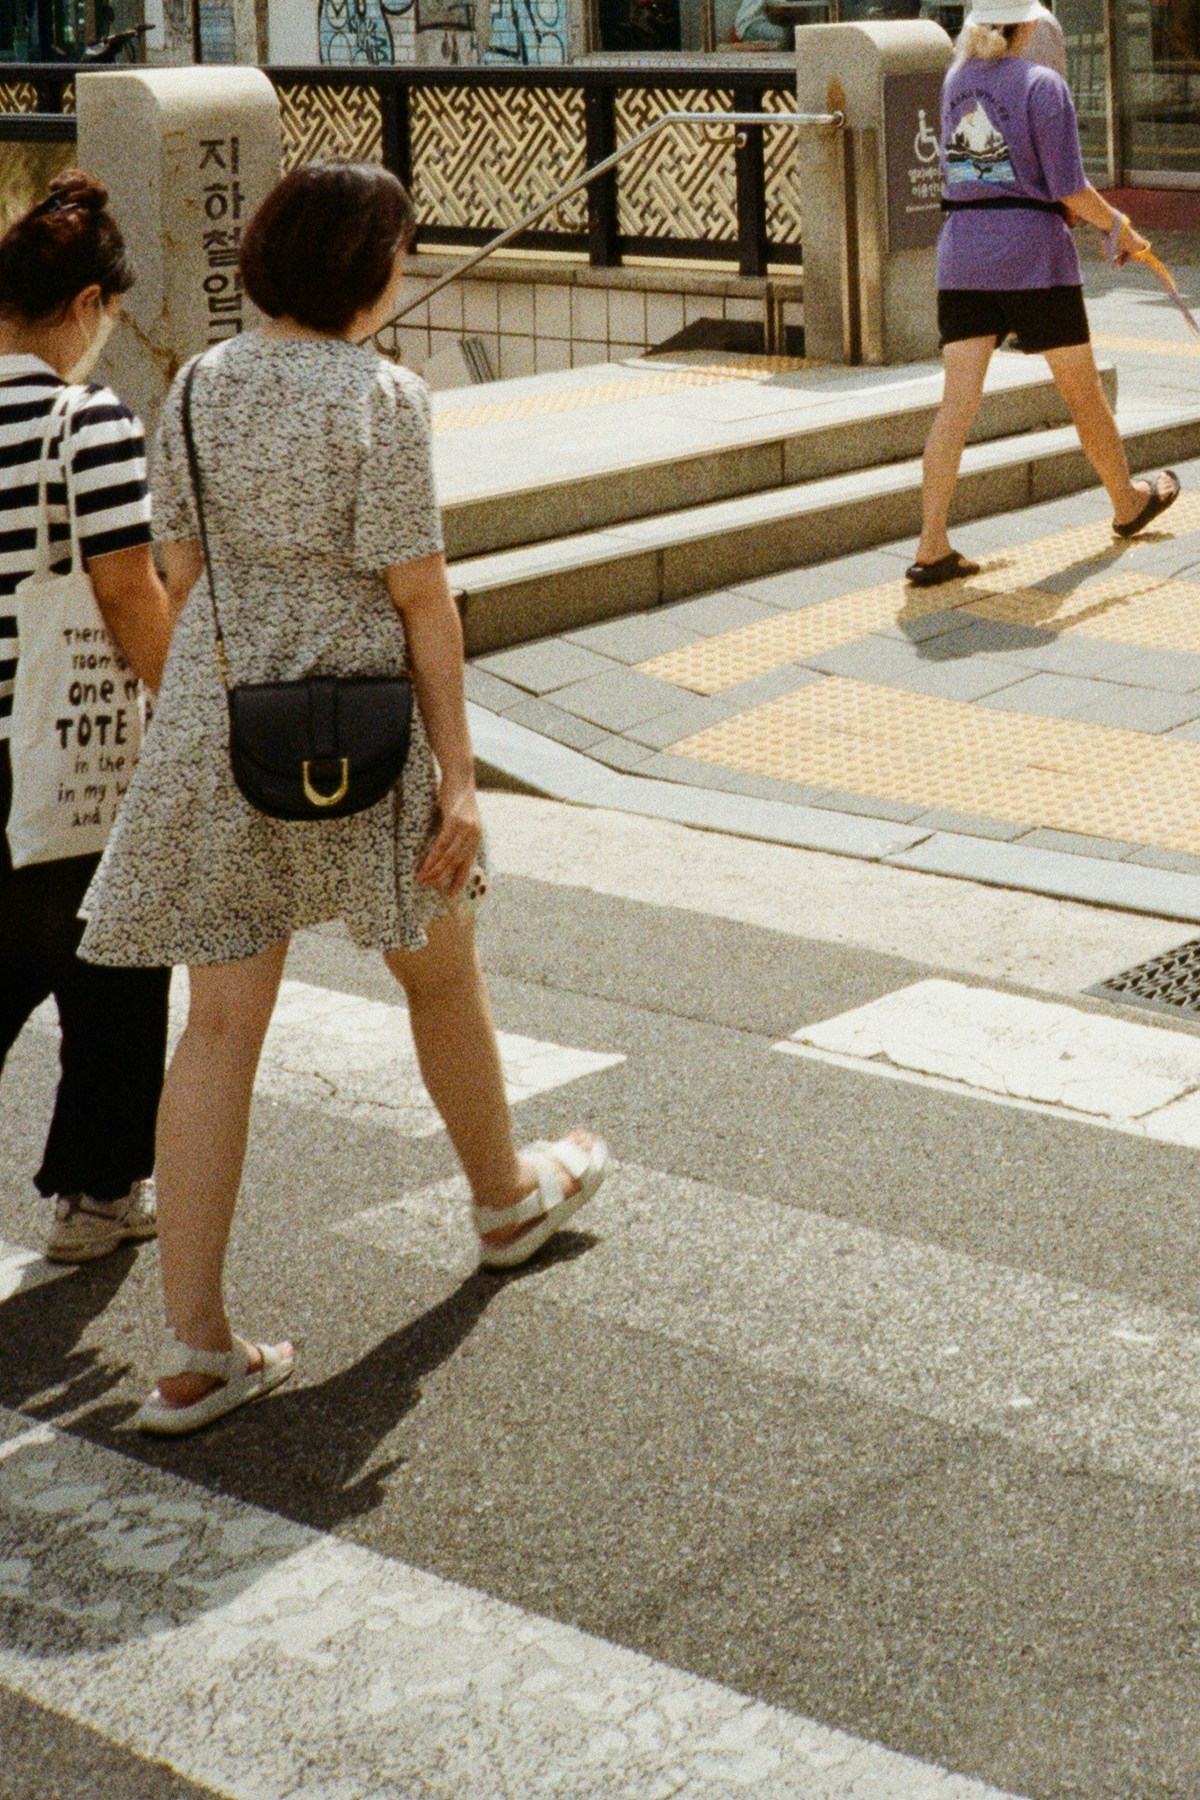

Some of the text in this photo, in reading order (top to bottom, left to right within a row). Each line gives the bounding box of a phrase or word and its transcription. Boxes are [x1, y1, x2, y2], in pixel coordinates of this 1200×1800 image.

[68, 679, 115, 707] one
[56, 708, 128, 749] TOTE
[74, 754, 90, 774] in
[98, 753, 126, 773] the
[57, 782, 76, 803] in
[84, 784, 107, 804] my
[71, 805, 101, 828] and
